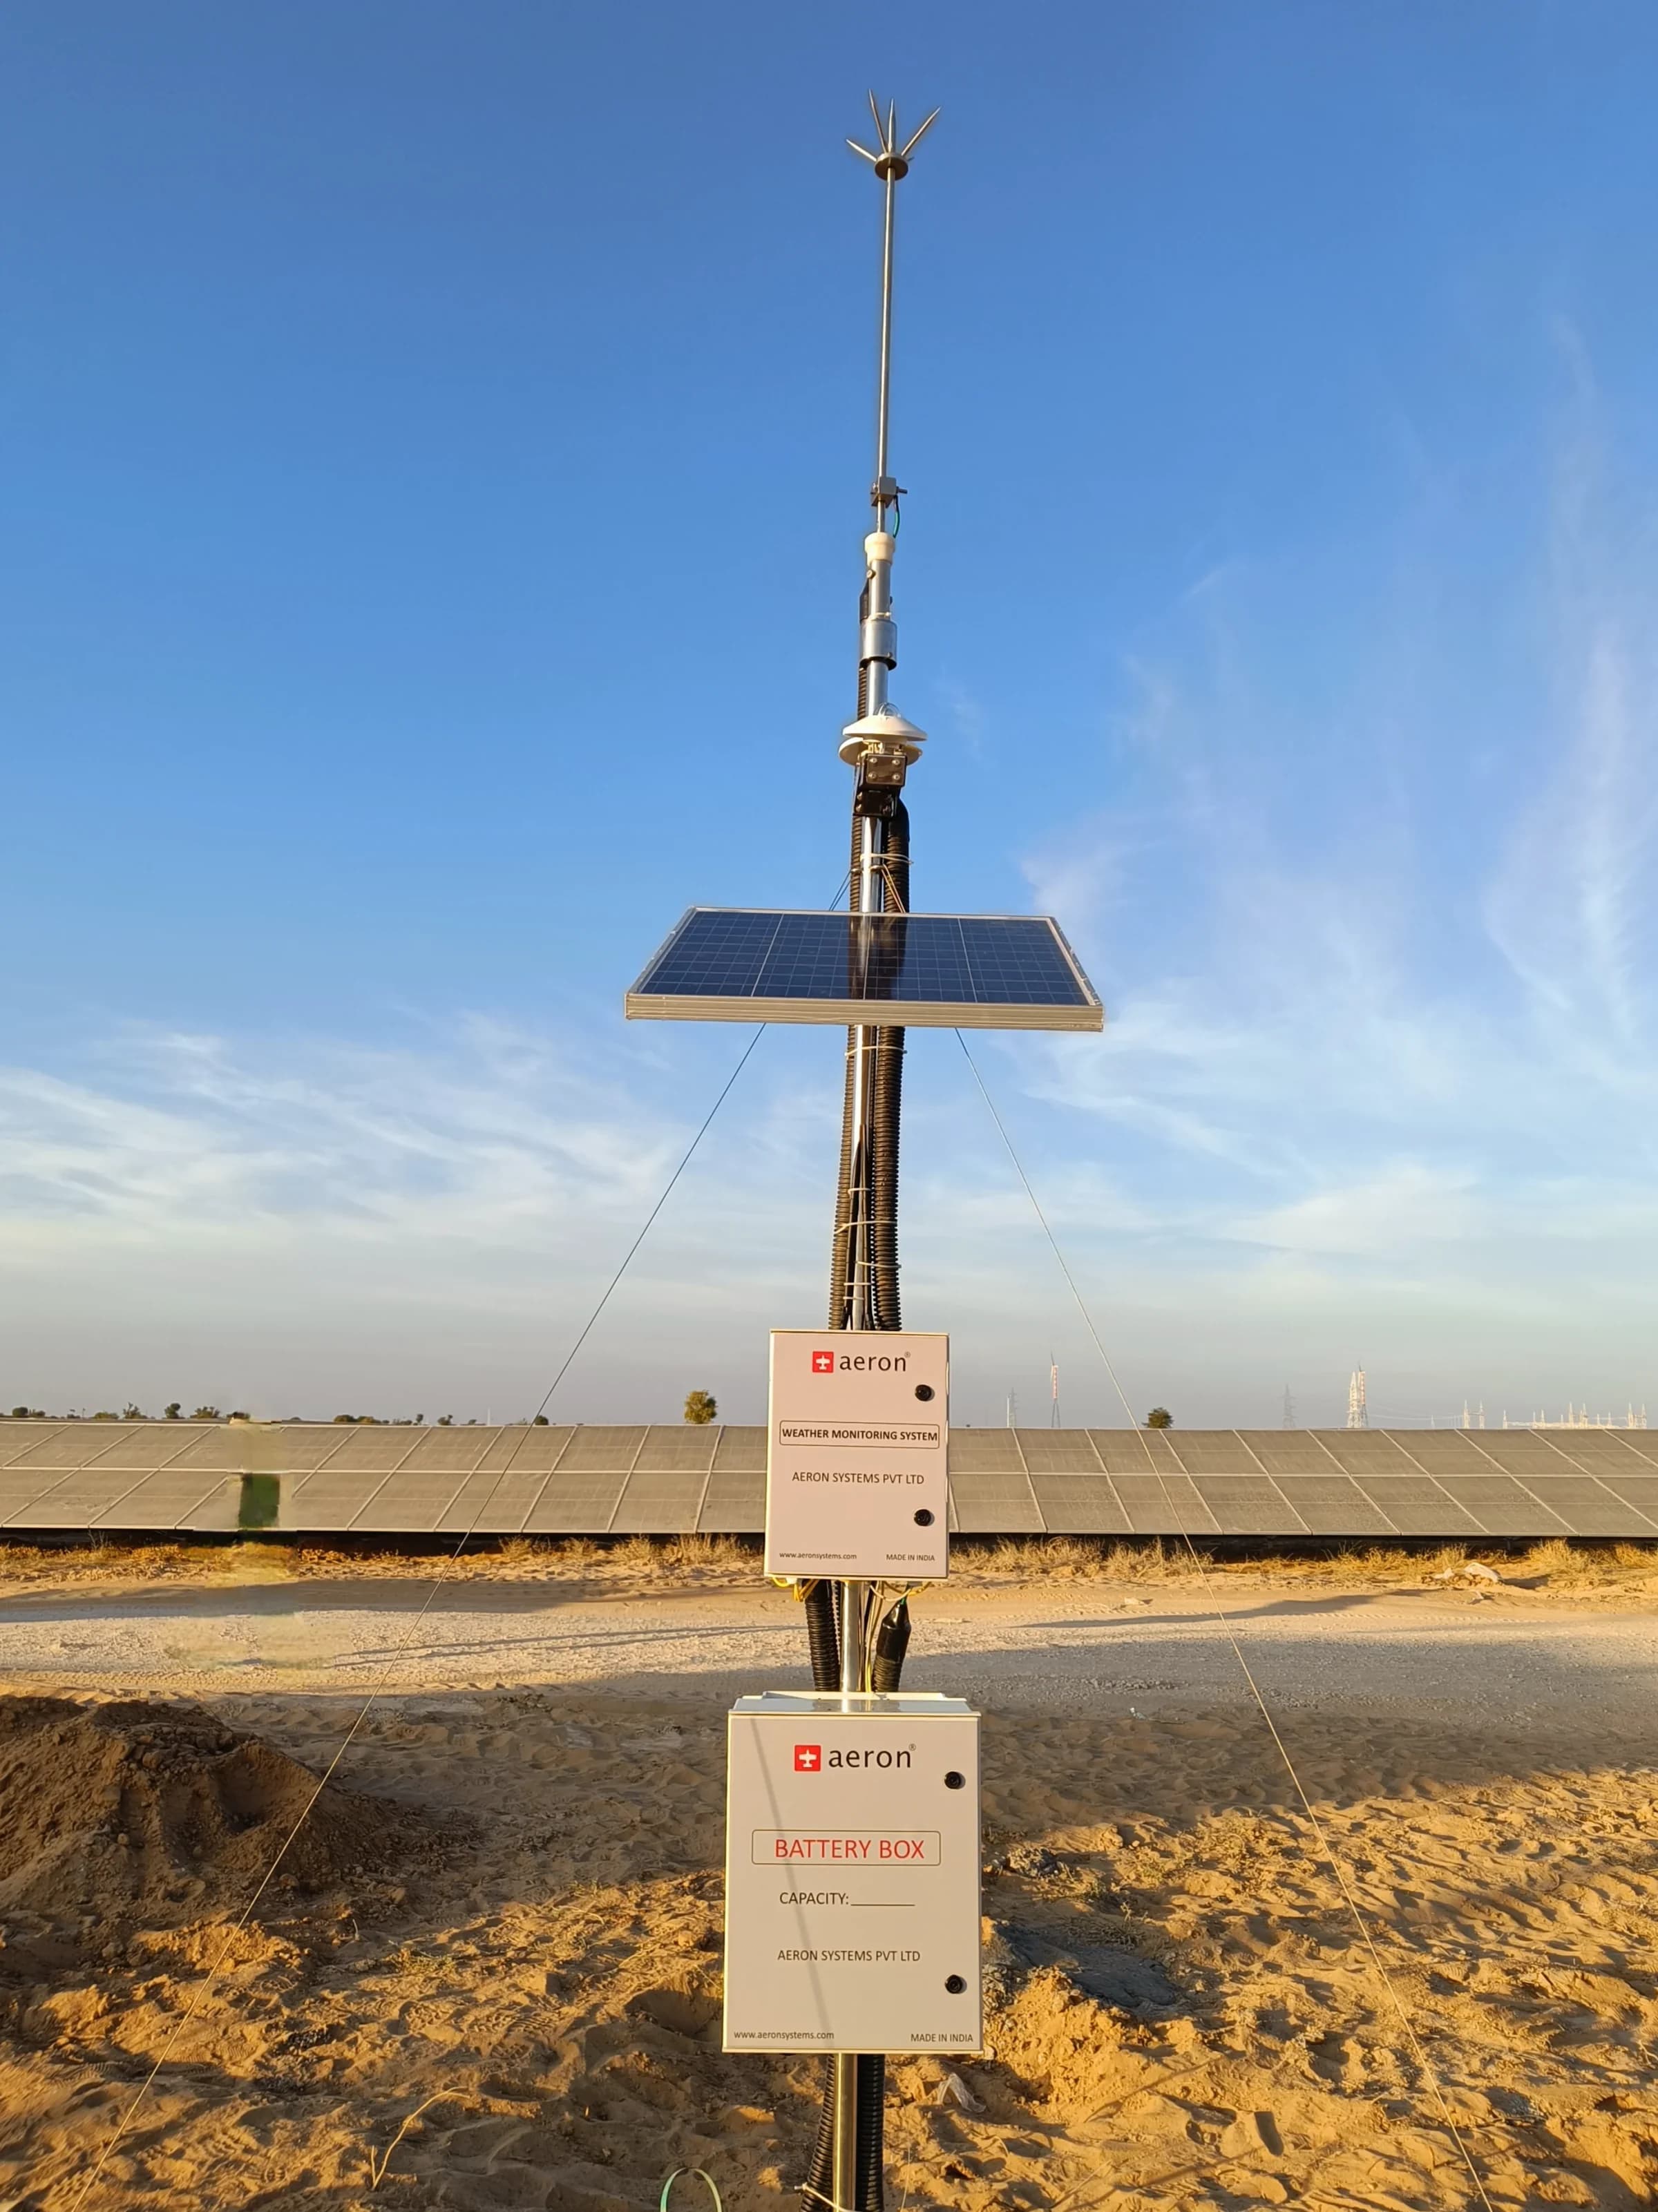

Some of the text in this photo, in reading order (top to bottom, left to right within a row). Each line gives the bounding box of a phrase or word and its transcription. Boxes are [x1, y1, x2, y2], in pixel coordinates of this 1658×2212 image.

[839, 1354, 906, 1371] aeron
[782, 1428, 937, 1441] WEATHER MONITORING SYSTEM
[792, 1471, 924, 1485] AERON SYSTEMS PVT LTD
[779, 1552, 857, 1560] www.aeronsystems.com
[828, 1748, 911, 1768] aeron
[774, 1838, 924, 1859] BATTERY BOX
[779, 1891, 850, 1906] CAPACITY:
[777, 1949, 921, 1962] AERON SYSTEMS PVT LTD
[734, 2030, 835, 2041] www.aeronsystems.com
[910, 2032, 973, 2043] MADE IN INDIA
